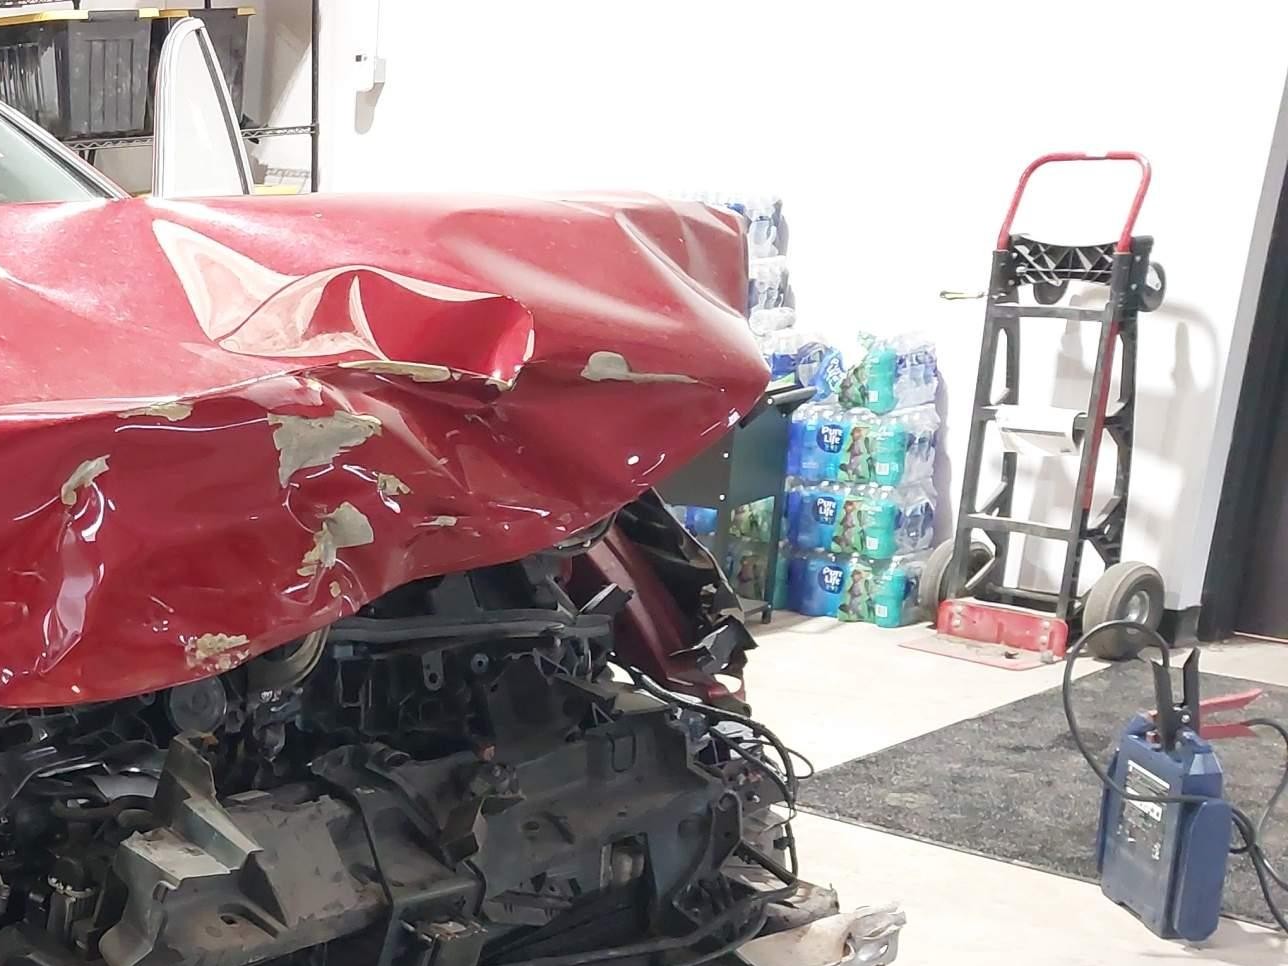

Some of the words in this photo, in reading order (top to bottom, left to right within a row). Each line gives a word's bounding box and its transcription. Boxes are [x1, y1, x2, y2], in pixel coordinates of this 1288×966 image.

[821, 426, 843, 437] Pure
[823, 434, 841, 446] Life
[816, 498, 837, 509] Pure
[819, 506, 835, 517] Life
[822, 566, 843, 578] Pure
[824, 574, 841, 586] Life
